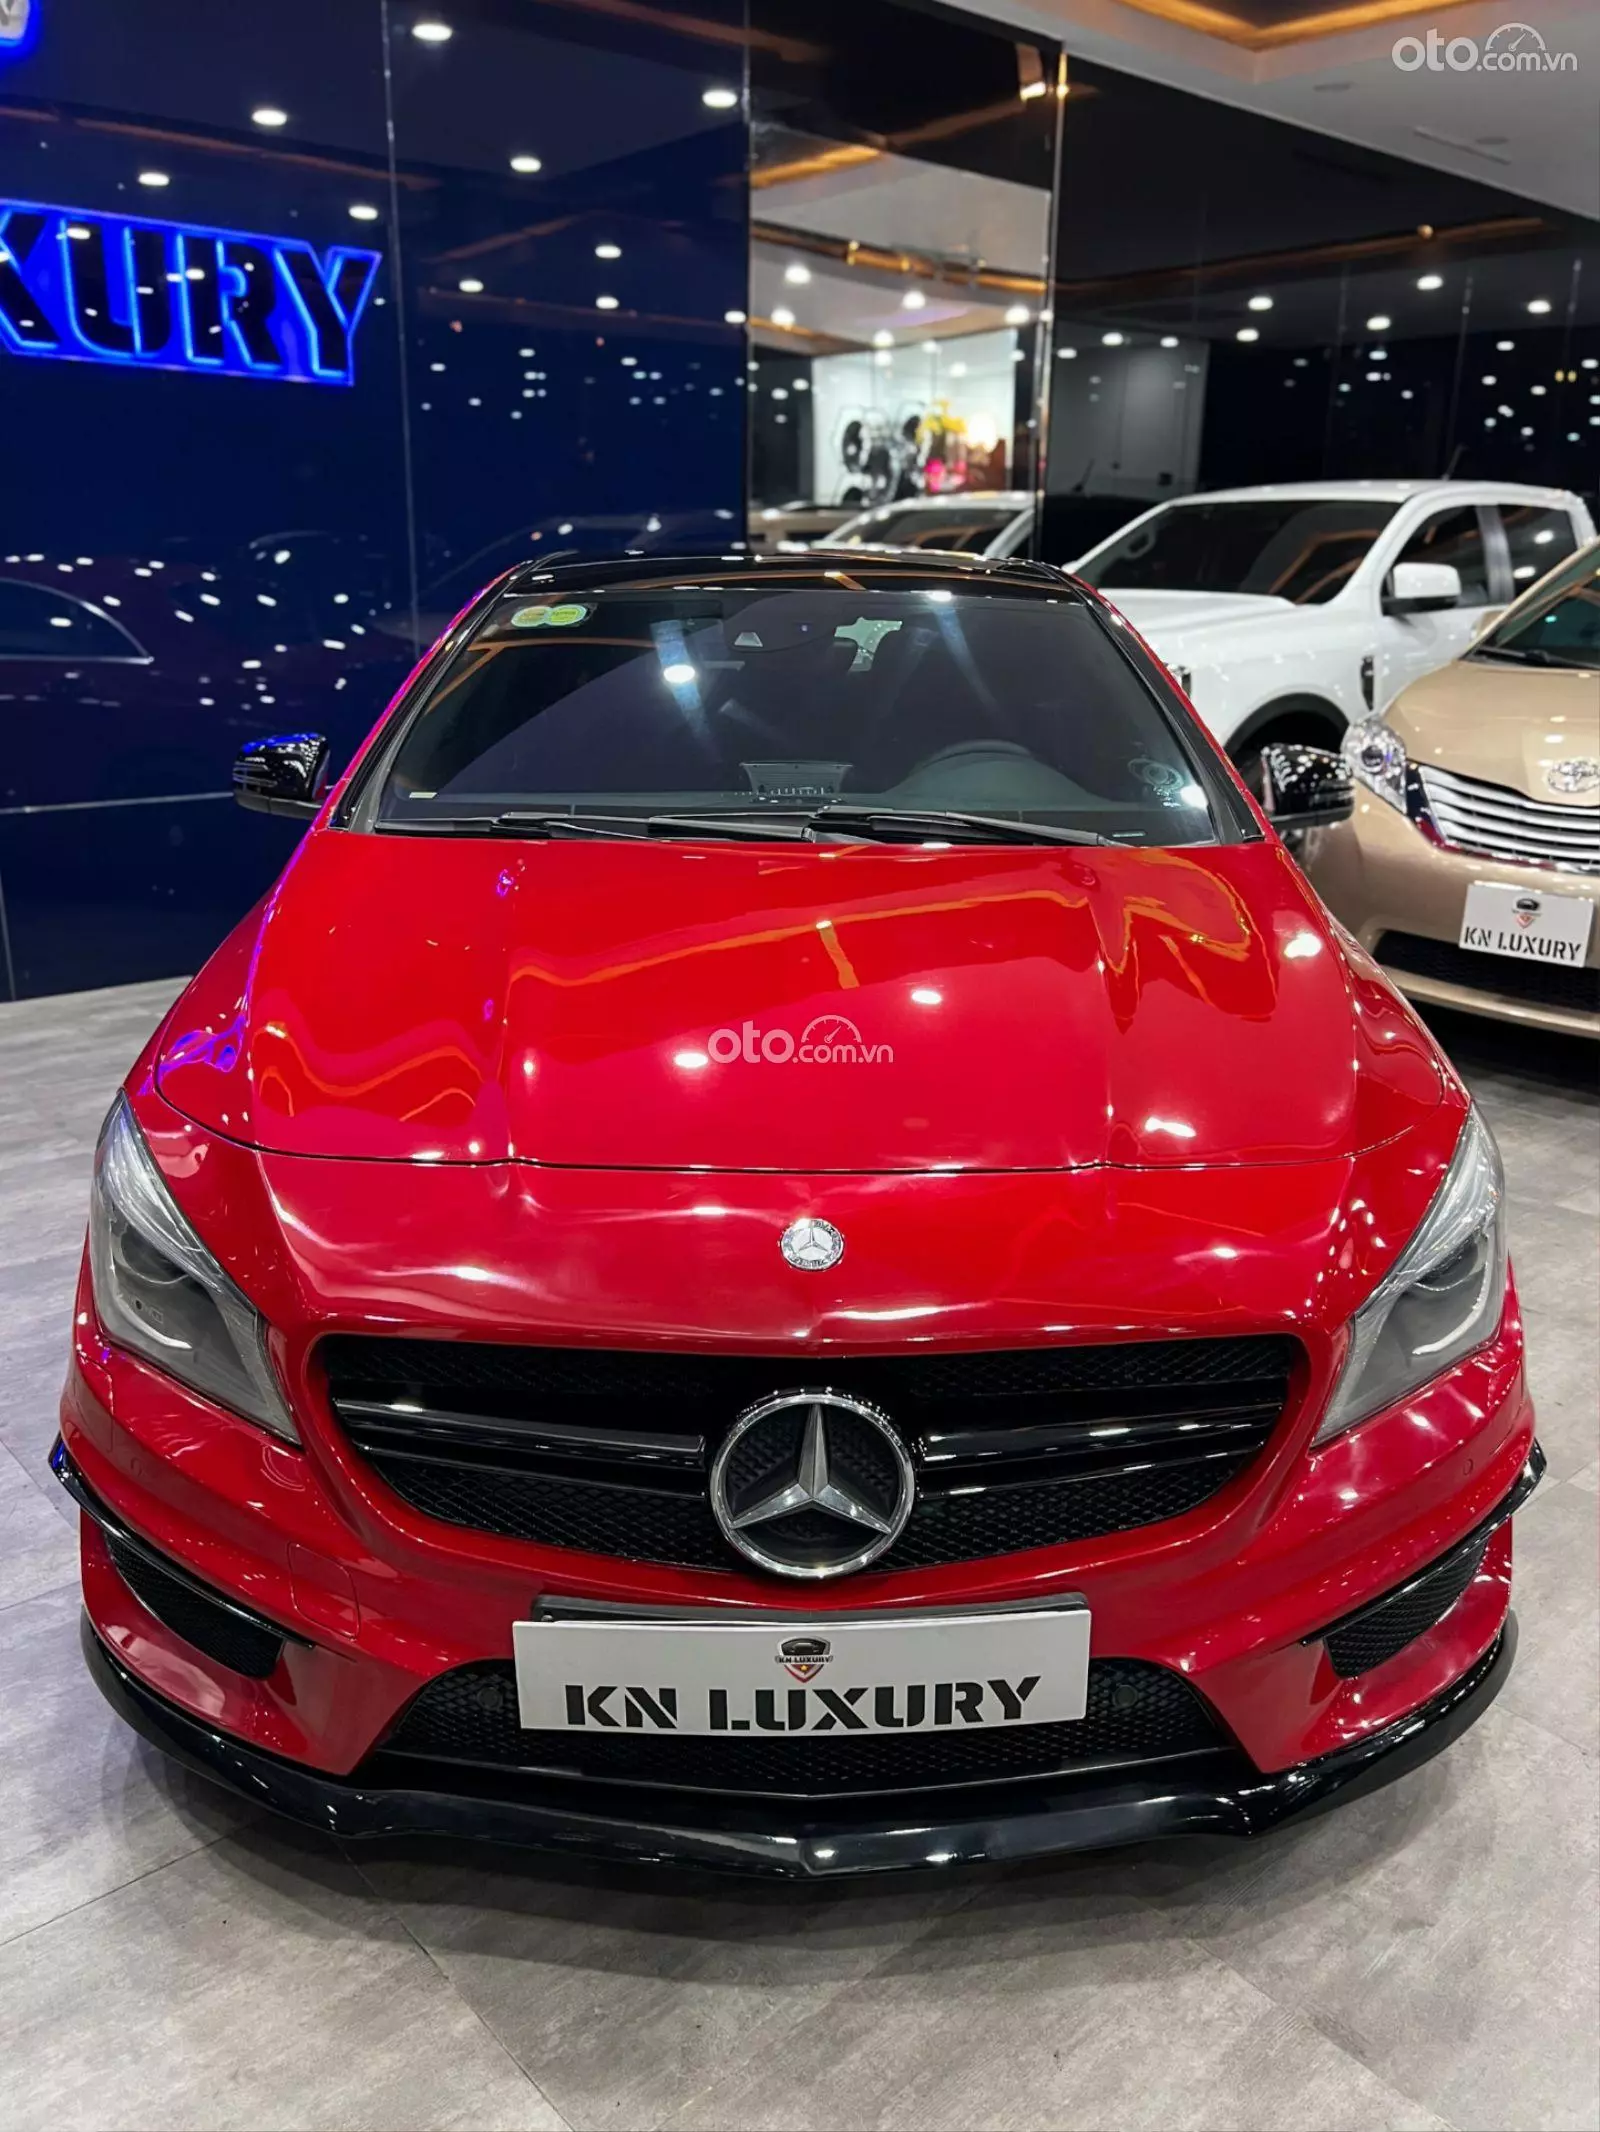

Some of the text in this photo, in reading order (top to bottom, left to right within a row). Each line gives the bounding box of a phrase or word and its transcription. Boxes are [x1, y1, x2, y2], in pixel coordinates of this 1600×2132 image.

[1464, 926, 1581, 961] KN LUXURY
[564, 1675, 1042, 1731] KN LUXURY
